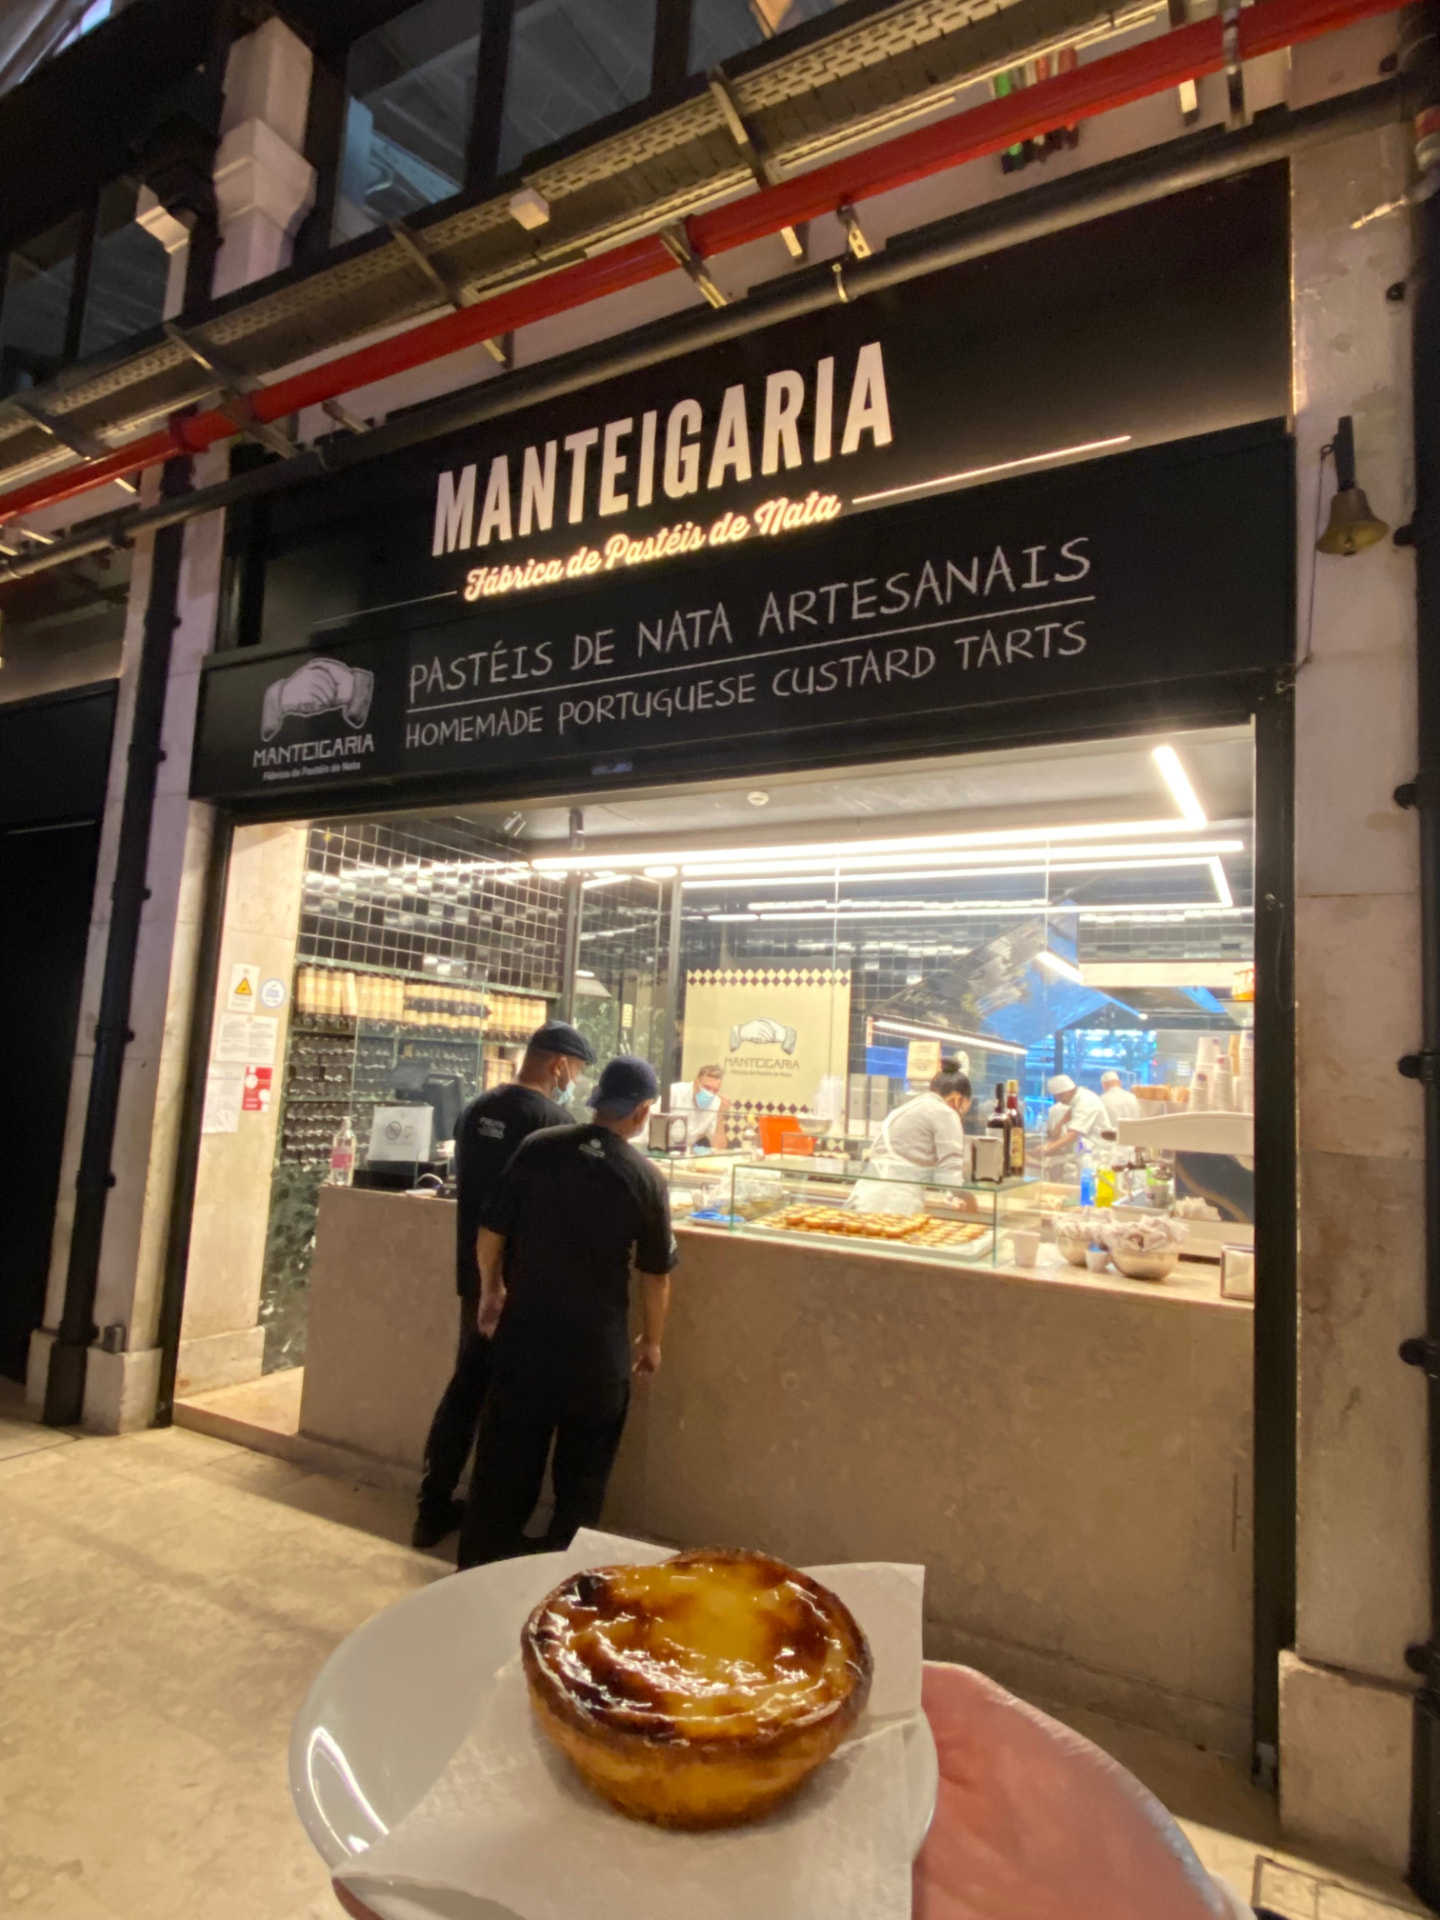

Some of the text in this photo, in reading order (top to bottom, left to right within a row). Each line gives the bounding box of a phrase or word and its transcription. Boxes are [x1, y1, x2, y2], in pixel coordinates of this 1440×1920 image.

[432, 341, 893, 557] MANTEIGARIA
[464, 490, 842, 602] Fábrica de Pastéis de Nata
[409, 536, 1092, 704] PASTÉIS DE NATA ARTESANAIS
[405, 621, 1088, 749] HOMEMADE PORTUGUESE CUSTARD TARTS
[252, 733, 375, 768] MANTEIGARIA
[724, 1056, 800, 1070] MANTEIGARIA
